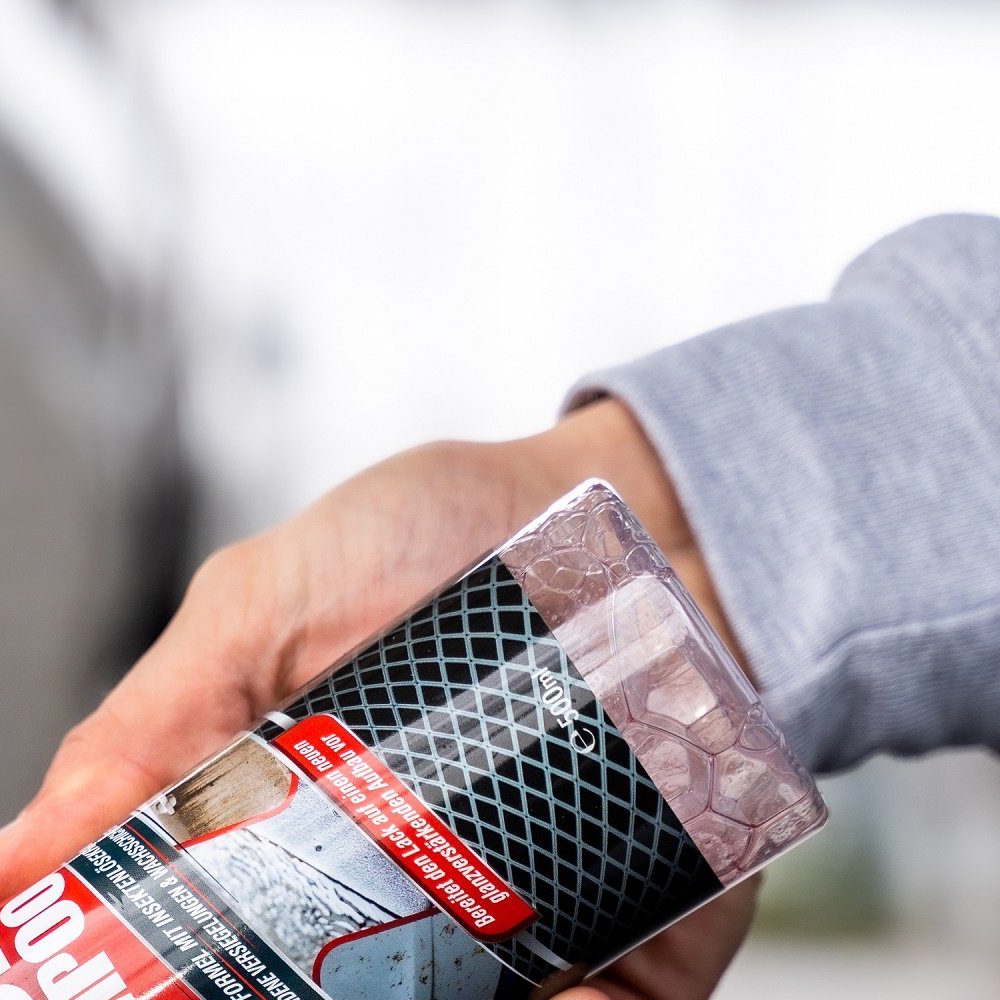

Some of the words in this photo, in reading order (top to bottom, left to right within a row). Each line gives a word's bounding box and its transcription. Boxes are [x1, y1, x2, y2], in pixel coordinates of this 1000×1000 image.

[531, 667, 579, 729] 500ml
[293, 740, 333, 772] neuen
[321, 733, 346, 753] vor
[325, 769, 366, 804] einen
[340, 750, 389, 791] Aufbau
[356, 803, 389, 825] auf
[381, 824, 420, 858] Lack
[381, 789, 510, 903] glanzverstärkenden
[160, 876, 178, 888] &
[414, 855, 446, 880] den
[436, 879, 495, 928] Bereitet
[162, 926, 199, 952] MIT
[167, 885, 264, 977] VERSIEGELUNGEN
